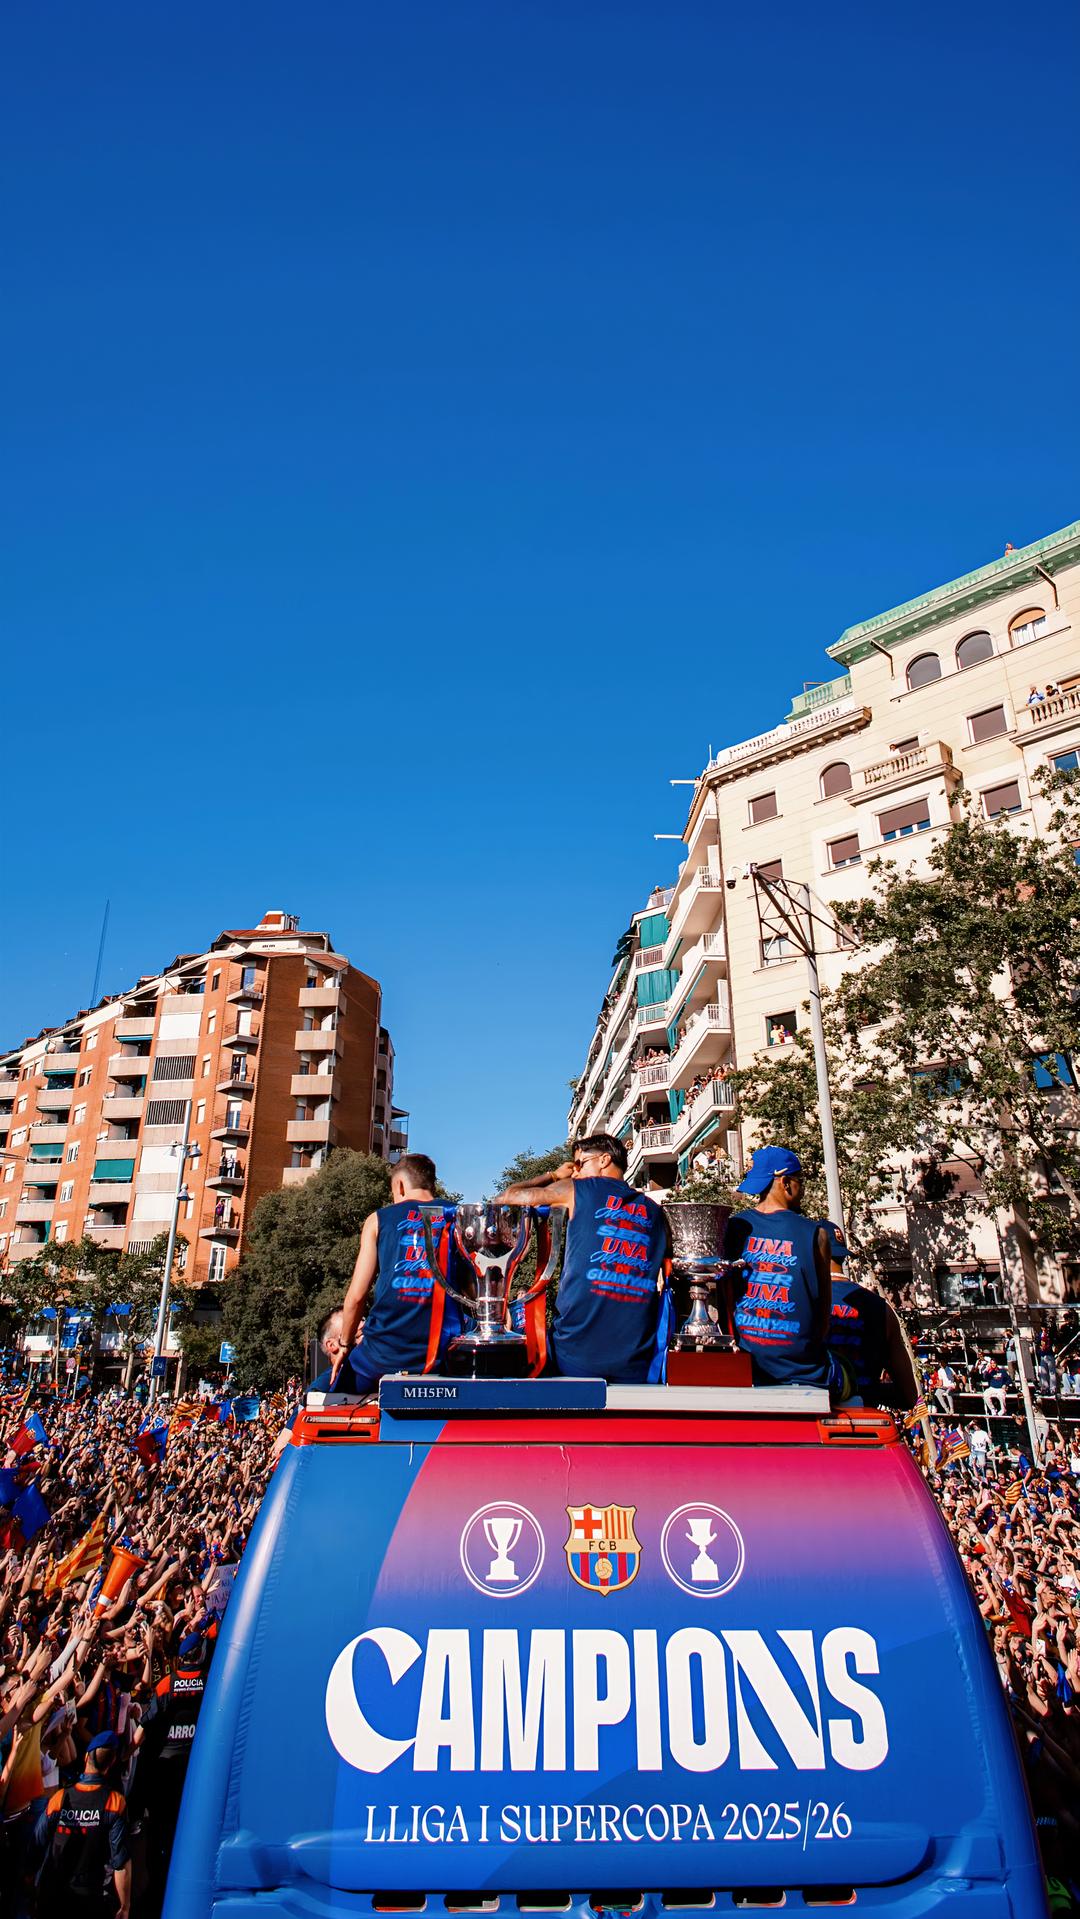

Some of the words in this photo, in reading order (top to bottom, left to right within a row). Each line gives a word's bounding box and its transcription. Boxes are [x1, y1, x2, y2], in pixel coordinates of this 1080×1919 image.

[606, 1195, 648, 1219] UNA
[596, 1225, 650, 1247] SER
[602, 1237, 648, 1262] UNA
[747, 1236, 793, 1257] UNA
[757, 1261, 774, 1273] DE
[742, 1270, 793, 1287] ER
[746, 1282, 790, 1304] UNA
[755, 1307, 772, 1319] DE
[404, 1387, 457, 1398] MH5FM
[588, 1540, 617, 1551] FCB
[174, 1679, 204, 1689] POLICIA
[325, 1626, 889, 1774] CAMPIONS
[167, 1724, 196, 1739] ARRO
[60, 1809, 100, 1821] POLICIA
[363, 1805, 469, 1843] LLIGA
[478, 1805, 490, 1842] I
[500, 1804, 715, 1843] SUPERCOPA
[721, 1799, 852, 1851] 2025/26
